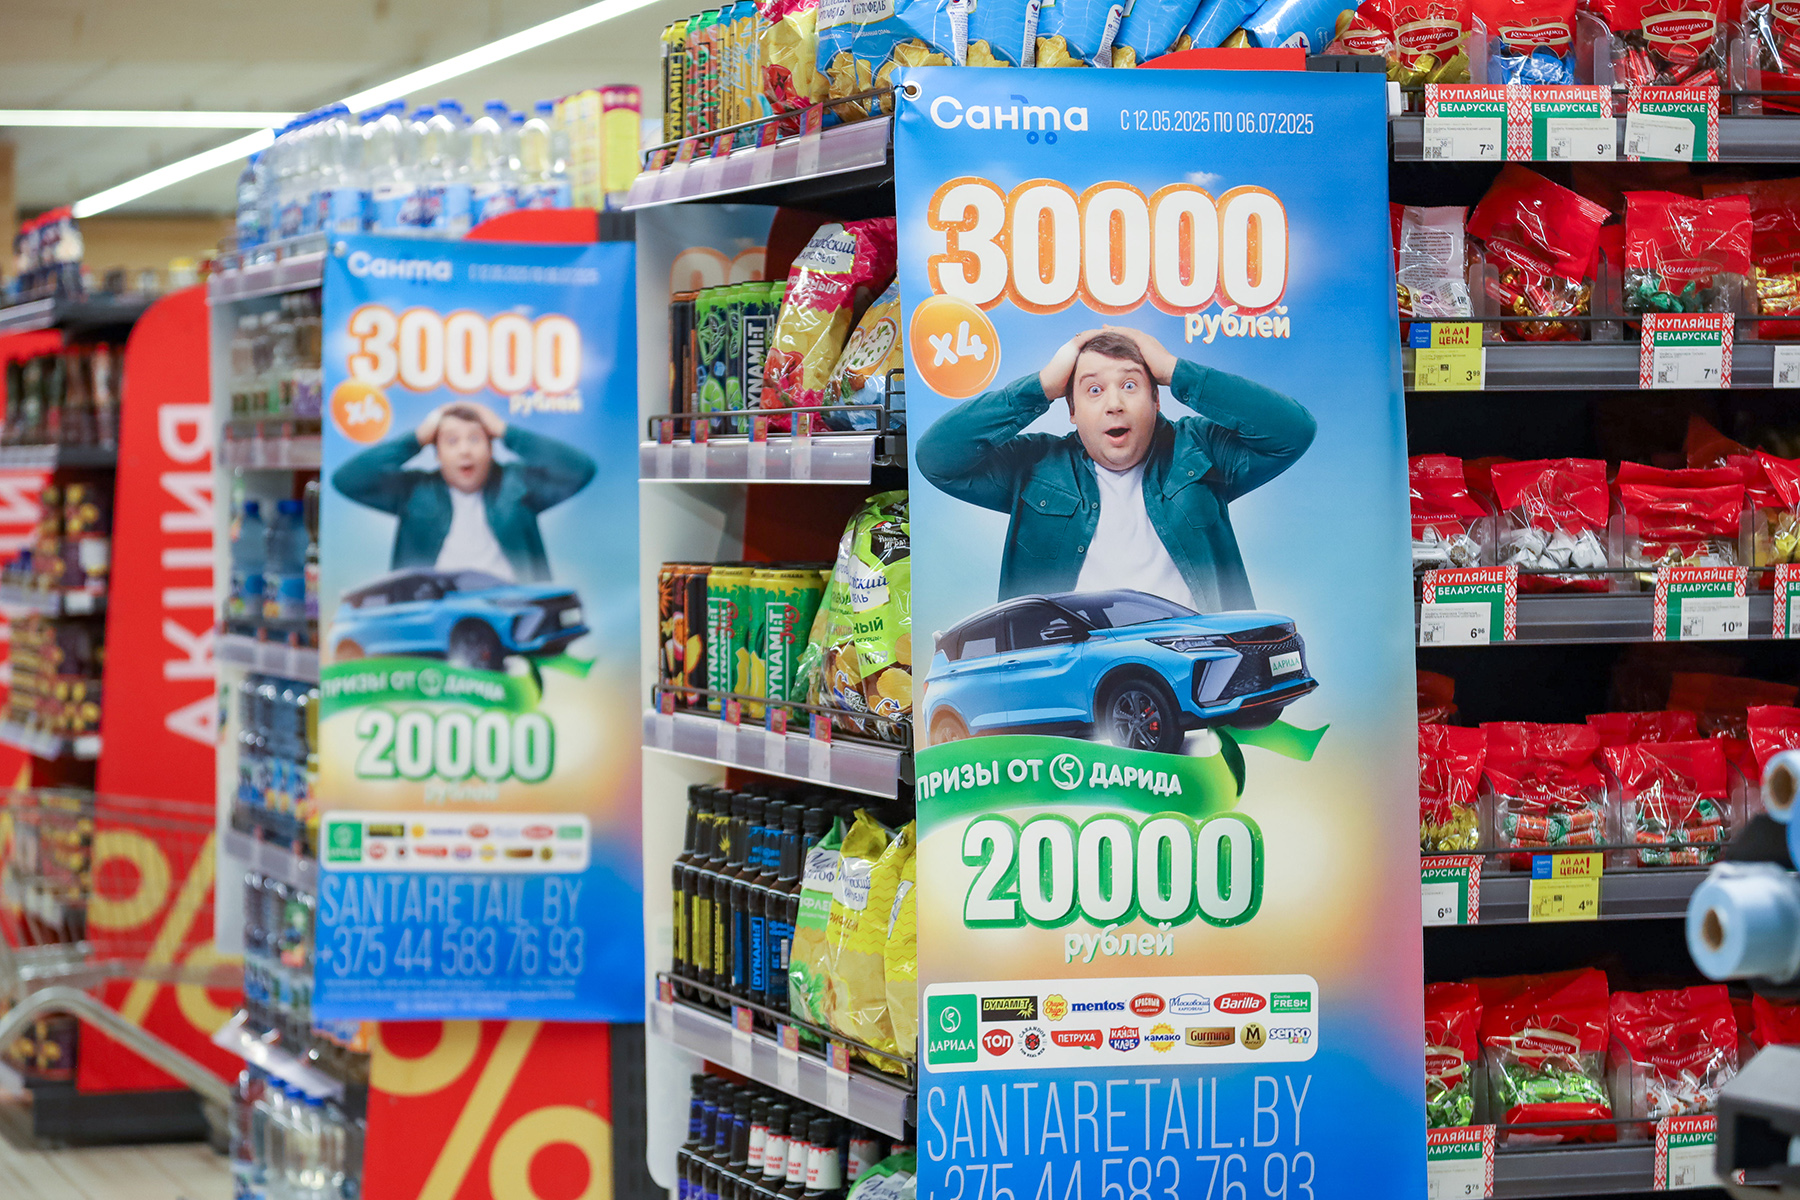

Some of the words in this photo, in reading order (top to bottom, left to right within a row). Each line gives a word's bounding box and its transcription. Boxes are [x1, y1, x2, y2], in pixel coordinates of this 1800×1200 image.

[1651, 21, 1709, 34] Коммунарка
[1440, 89, 1505, 101] КУПЛЯЙЦЕ
[1533, 89, 1598, 101] КУПЛЯЙЦЕ
[1643, 89, 1707, 101] КУПЛЯЙЦЕ
[930, 96, 1089, 132] Санта
[1440, 103, 1505, 112] БЕЛАРУСКАЕ
[1533, 103, 1598, 112] БЕЛАРУСКАЕ
[1642, 104, 1706, 113] БЕЛАРУСКАЕ
[1120, 110, 1131, 130] С
[1134, 110, 1211, 133] 12.05.2025
[1213, 111, 1234, 133] ПО
[1236, 112, 1315, 135] 06.07.2025
[928, 176, 1289, 316] 30000
[1184, 306, 1291, 345] рублей
[1657, 317, 1721, 329] КУПЛЯЙЦЕ
[1656, 332, 1719, 341] БЕЛАРУСКАЕ
[349, 303, 582, 396] 30000
[1438, 570, 1504, 583] КУПЛЯЙЦЕ
[1671, 569, 1734, 580] КУПЛЯЙЦЕ
[1438, 585, 1503, 596] БЕЛАРУСКАЕ
[1670, 582, 1733, 592] БЕЛАРУСКАЕ
[1271, 655, 1301, 672] ДАРИДА
[355, 704, 555, 785] 20000
[916, 760, 999, 801] ПРИЗЫ
[1007, 759, 1044, 782] ОТ
[1088, 761, 1182, 797] ДАРИДА
[962, 811, 1265, 930] 20000
[320, 874, 583, 927] SANTARETAILBY
[1064, 921, 1175, 964] рублей
[440, 926, 497, 977] 583
[548, 926, 585, 976] 93
[1071, 1000, 1125, 1012] mentos
[1220, 997, 1260, 1009] Barilla
[1273, 999, 1308, 1007] FRESH
[1058, 1033, 1096, 1043] ПЕТРУХА
[1190, 1030, 1230, 1042] Gurmina
[1269, 1027, 1312, 1040] senso
[929, 1039, 976, 1053] ДАРИДА
[984, 1034, 1011, 1049] ТОП
[926, 1074, 1313, 1162] SANTARETAIL.BY
[1427, 1130, 1482, 1144] УПЛЯЙЦЕ
[1428, 1142, 1480, 1155] ЛАРУСКАЕ
